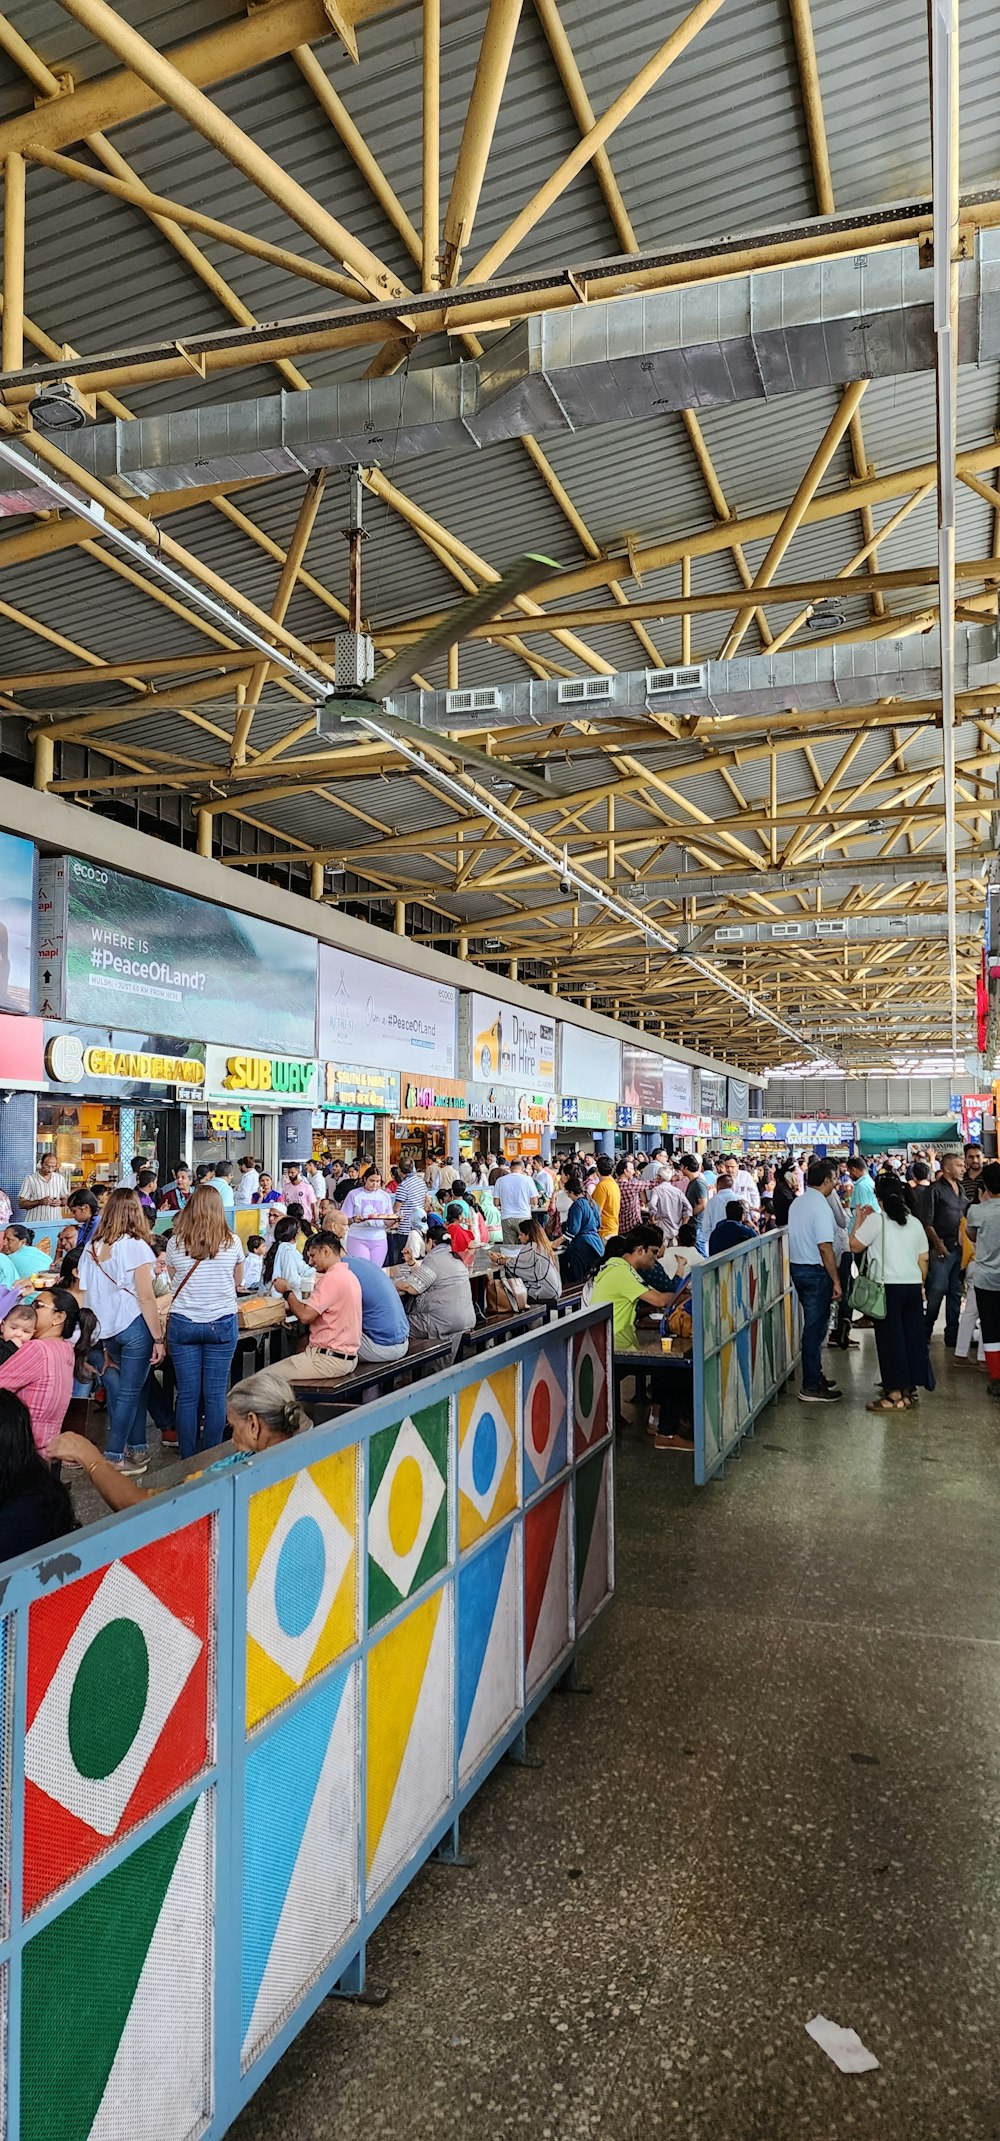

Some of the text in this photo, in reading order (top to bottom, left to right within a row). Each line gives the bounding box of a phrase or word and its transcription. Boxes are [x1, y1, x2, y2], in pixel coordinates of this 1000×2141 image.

[38, 901, 53, 913] apl
[91, 926, 149, 954] WHERE IS
[90, 946, 206, 991] #PeaceOfLand?
[91, 976, 113, 986] MULSHI
[118, 981, 132, 991] JUST
[133, 984, 139, 992] 60
[140, 986, 149, 994] KM
[150, 987, 165, 998] FROM
[165, 991, 179, 1000] HERE
[388, 1014, 436, 1036] #PeaceOfLand
[512, 1014, 537, 1050] Driver
[222, 1056, 317, 1093] SUBWAY
[519, 1049, 536, 1076] Hire
[209, 1104, 254, 1132] सबवे
[469, 1103, 495, 1118] KAILASH
[786, 1122, 841, 1137] AJFAN
